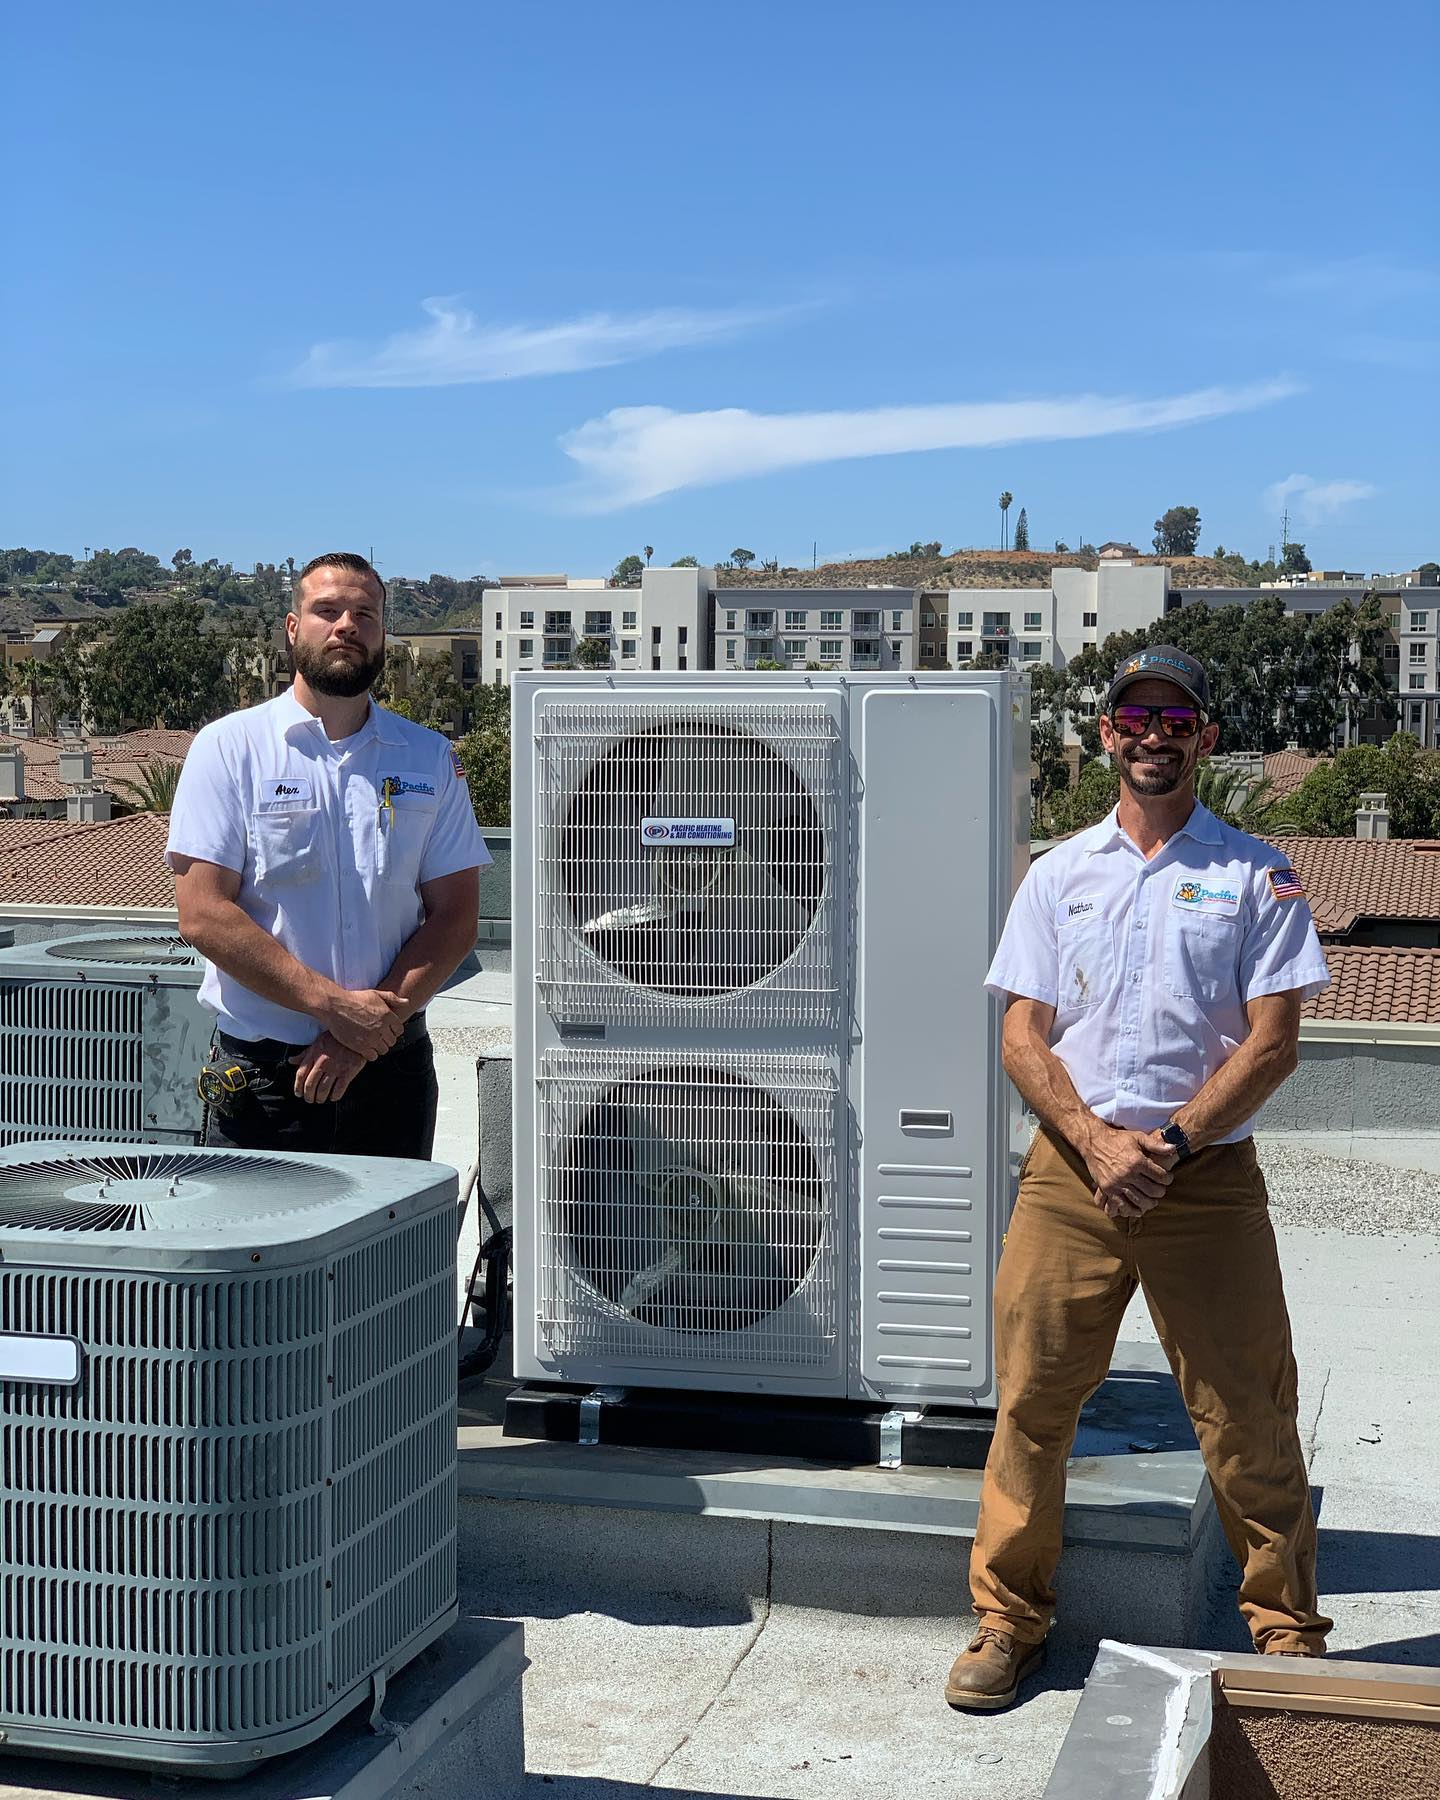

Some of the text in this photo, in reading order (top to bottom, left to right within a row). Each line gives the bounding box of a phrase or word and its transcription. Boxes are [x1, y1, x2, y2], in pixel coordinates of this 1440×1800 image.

[275, 784, 300, 796] Alex
[402, 781, 435, 793] Pacific
[670, 824, 722, 832] PACIFIC HEATING
[669, 831, 733, 840] & AIR CONDITIONING
[1200, 889, 1238, 901] Pacific
[1068, 902, 1094, 917] Nathan
